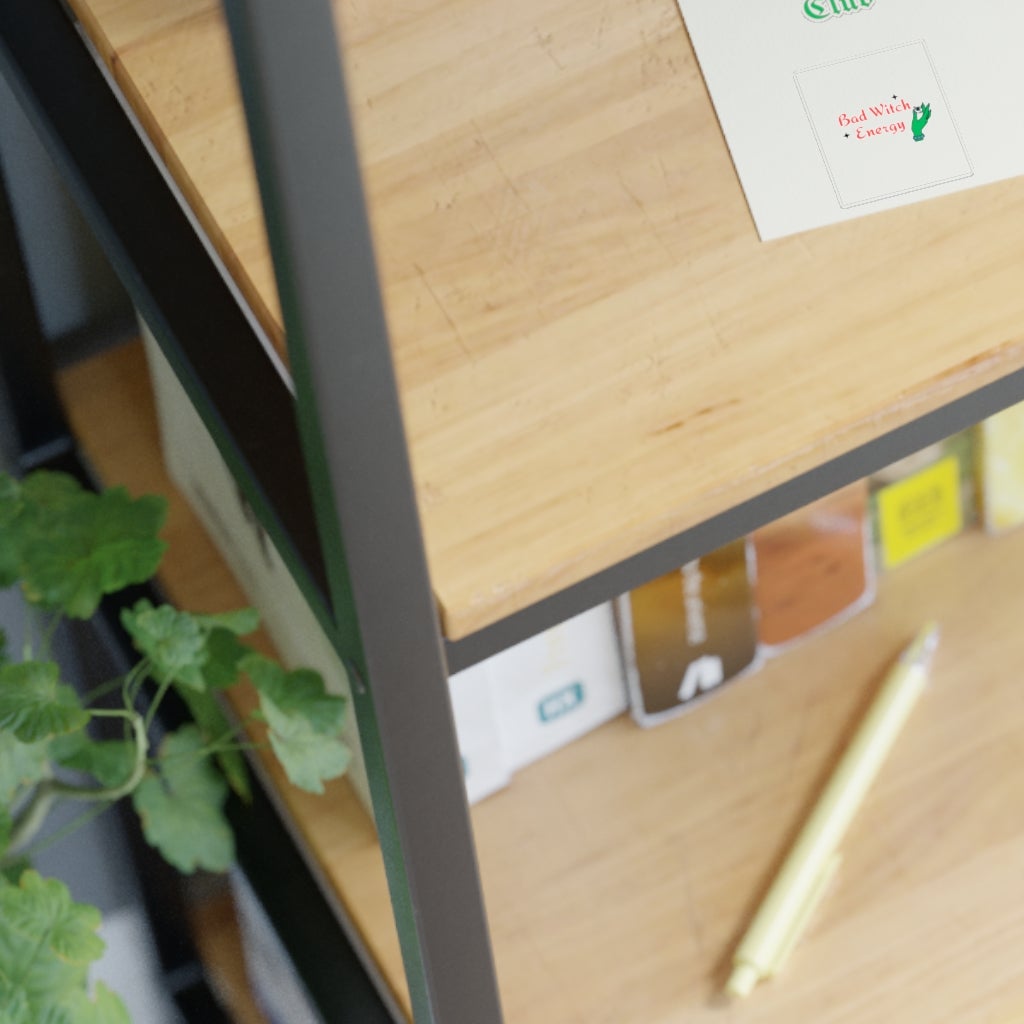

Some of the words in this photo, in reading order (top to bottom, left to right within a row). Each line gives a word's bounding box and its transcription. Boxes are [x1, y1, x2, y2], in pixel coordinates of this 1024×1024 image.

[838, 109, 868, 126] Bad
[869, 98, 911, 117] Witch
[856, 121, 905, 139] Energy
